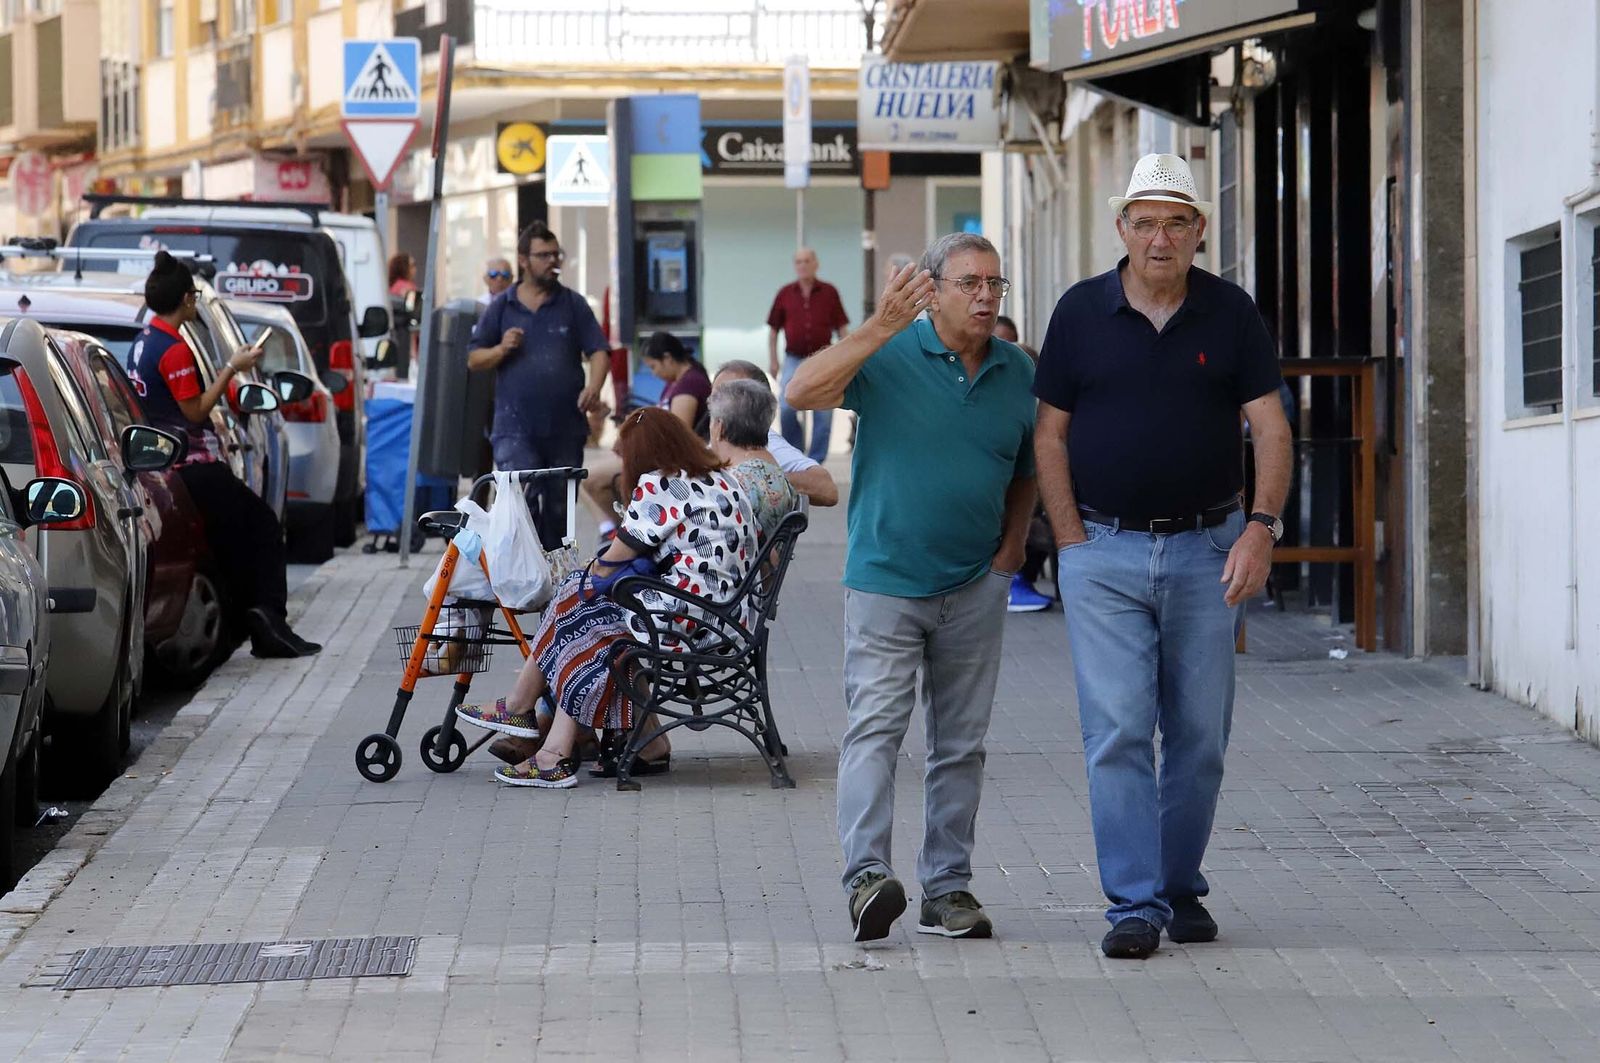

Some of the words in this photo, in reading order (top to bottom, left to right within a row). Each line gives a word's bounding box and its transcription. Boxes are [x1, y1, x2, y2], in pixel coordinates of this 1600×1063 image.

[866, 63, 994, 89] CRISTALERIA
[875, 91, 975, 119] HUELVA
[717, 132, 853, 162] Caixaank
[225, 277, 280, 294] GRUPO
